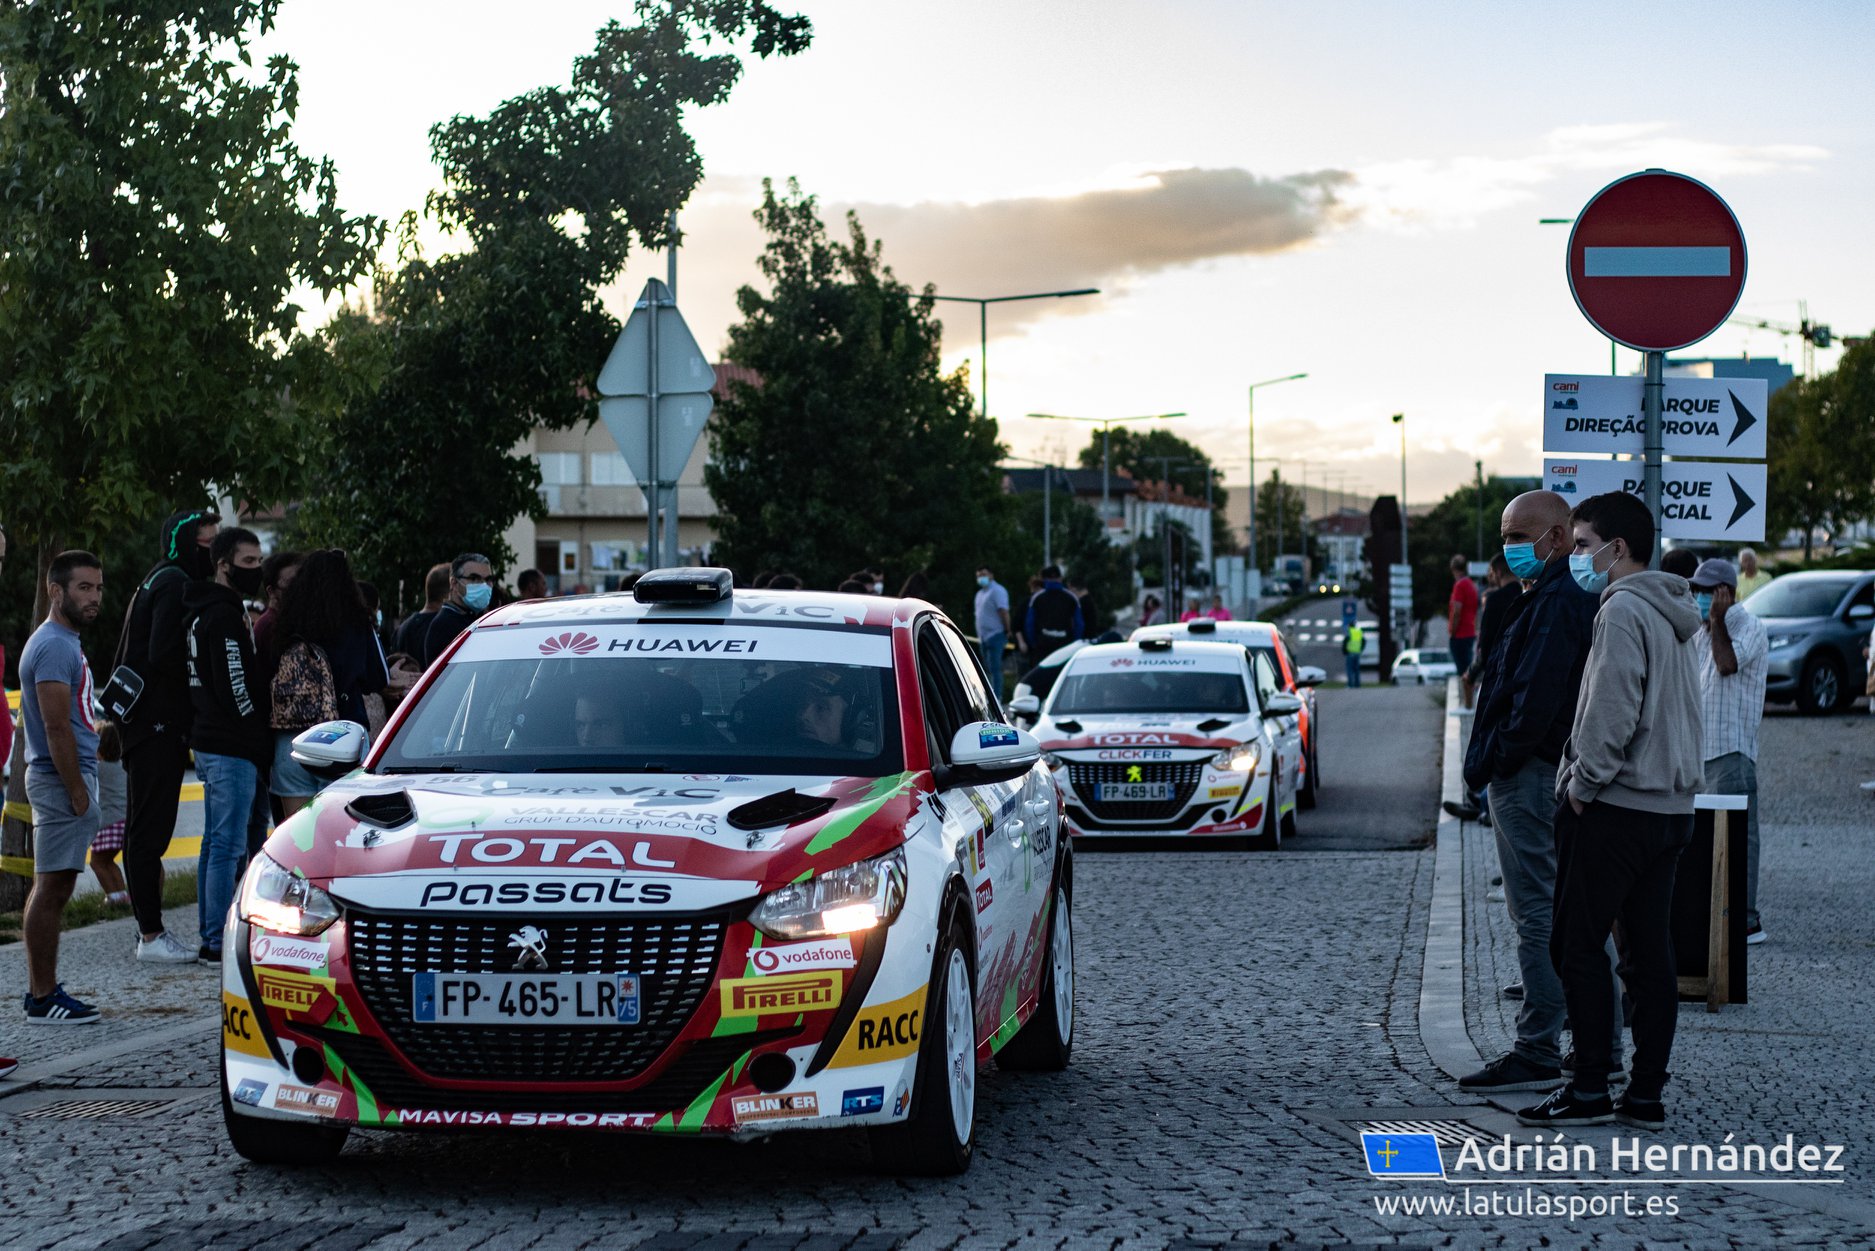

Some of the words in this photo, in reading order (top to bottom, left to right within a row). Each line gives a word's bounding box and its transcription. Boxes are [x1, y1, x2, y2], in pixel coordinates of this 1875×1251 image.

[1641, 397, 1720, 416] RQUE
[1565, 415, 1646, 437] DIREÇÃO
[1660, 503, 1713, 521] CIAL
[607, 638, 758, 654] HUAWEI
[225, 638, 255, 716] AFGHANISTAN
[1091, 733, 1180, 745] TOTAL
[1098, 749, 1172, 760] CLICKFER
[426, 775, 480, 785] 56
[504, 815, 562, 825] GRUP
[511, 807, 720, 825] VALLESCAR
[428, 833, 676, 868] TOTAL
[271, 946, 325, 962] vodafone
[782, 948, 852, 964] vodafone
[258, 973, 323, 1006] PIRELL
[442, 980, 617, 1017] FP-465-LR
[733, 978, 833, 1010] PIRELLI
[422, 1001, 429, 1013] F
[223, 1002, 251, 1040] ACC
[858, 1009, 919, 1050] RACC
[278, 1088, 338, 1108] BLINKER
[736, 1096, 816, 1114] BLINKER
[844, 1094, 883, 1109] RTS
[399, 1109, 502, 1125] MAVISA
[509, 1112, 656, 1128] SPORT
